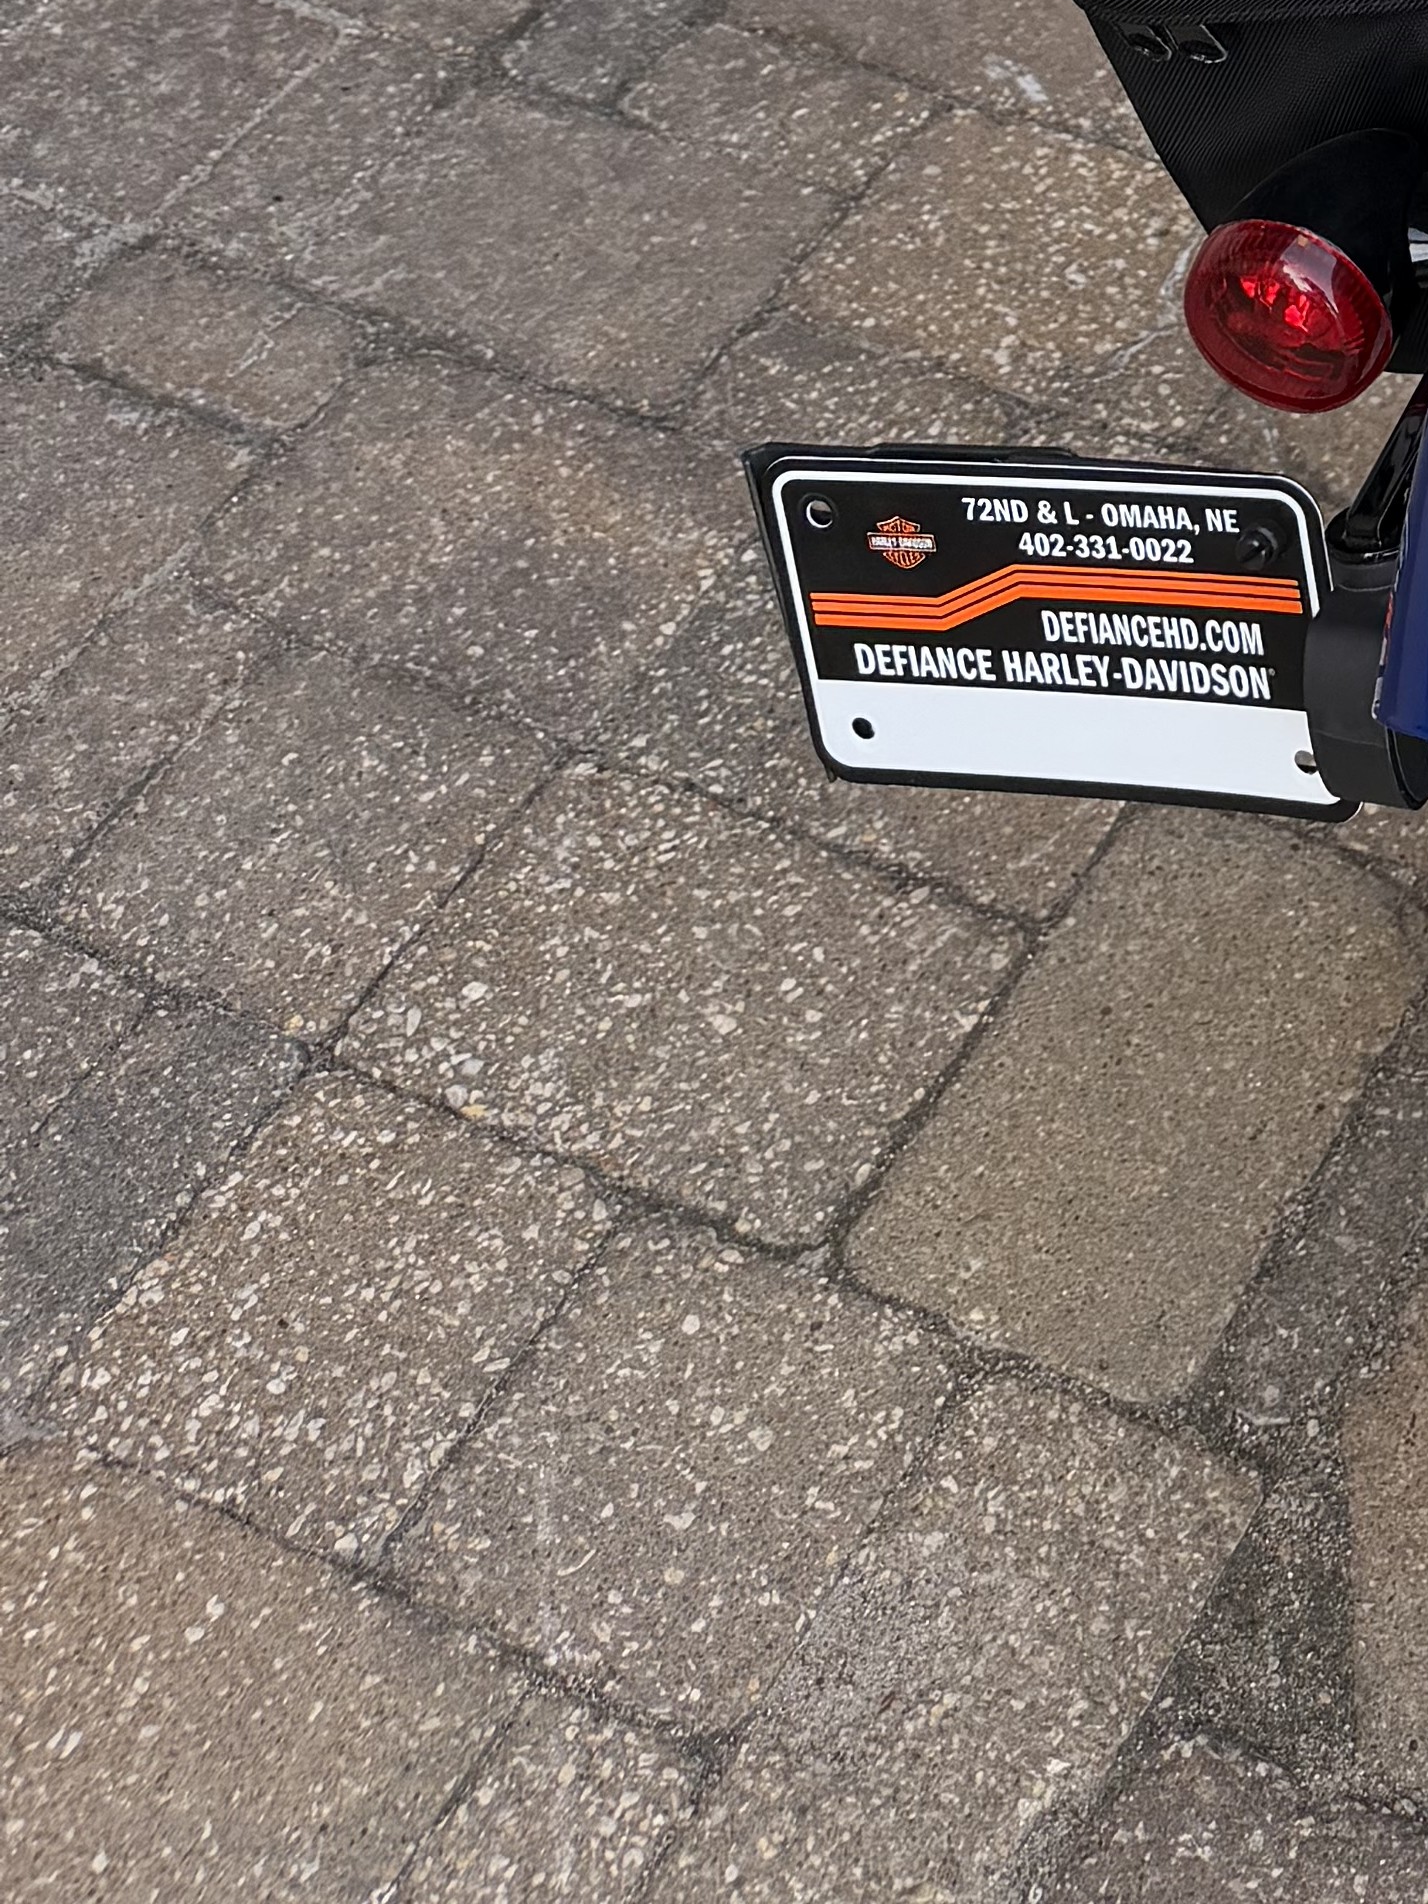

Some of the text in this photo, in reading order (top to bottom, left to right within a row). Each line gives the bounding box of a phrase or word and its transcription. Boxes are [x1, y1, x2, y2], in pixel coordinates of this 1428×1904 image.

[961, 496, 1029, 524] 72ND
[1036, 500, 1057, 525] &
[1064, 502, 1078, 527] L
[1101, 503, 1200, 536] OMAHA,
[1205, 507, 1239, 534] NE
[1018, 532, 1194, 564] 402-331-0022
[1041, 609, 1265, 656] DEFIANCEHD.COM
[853, 642, 997, 683] DEFIANCE
